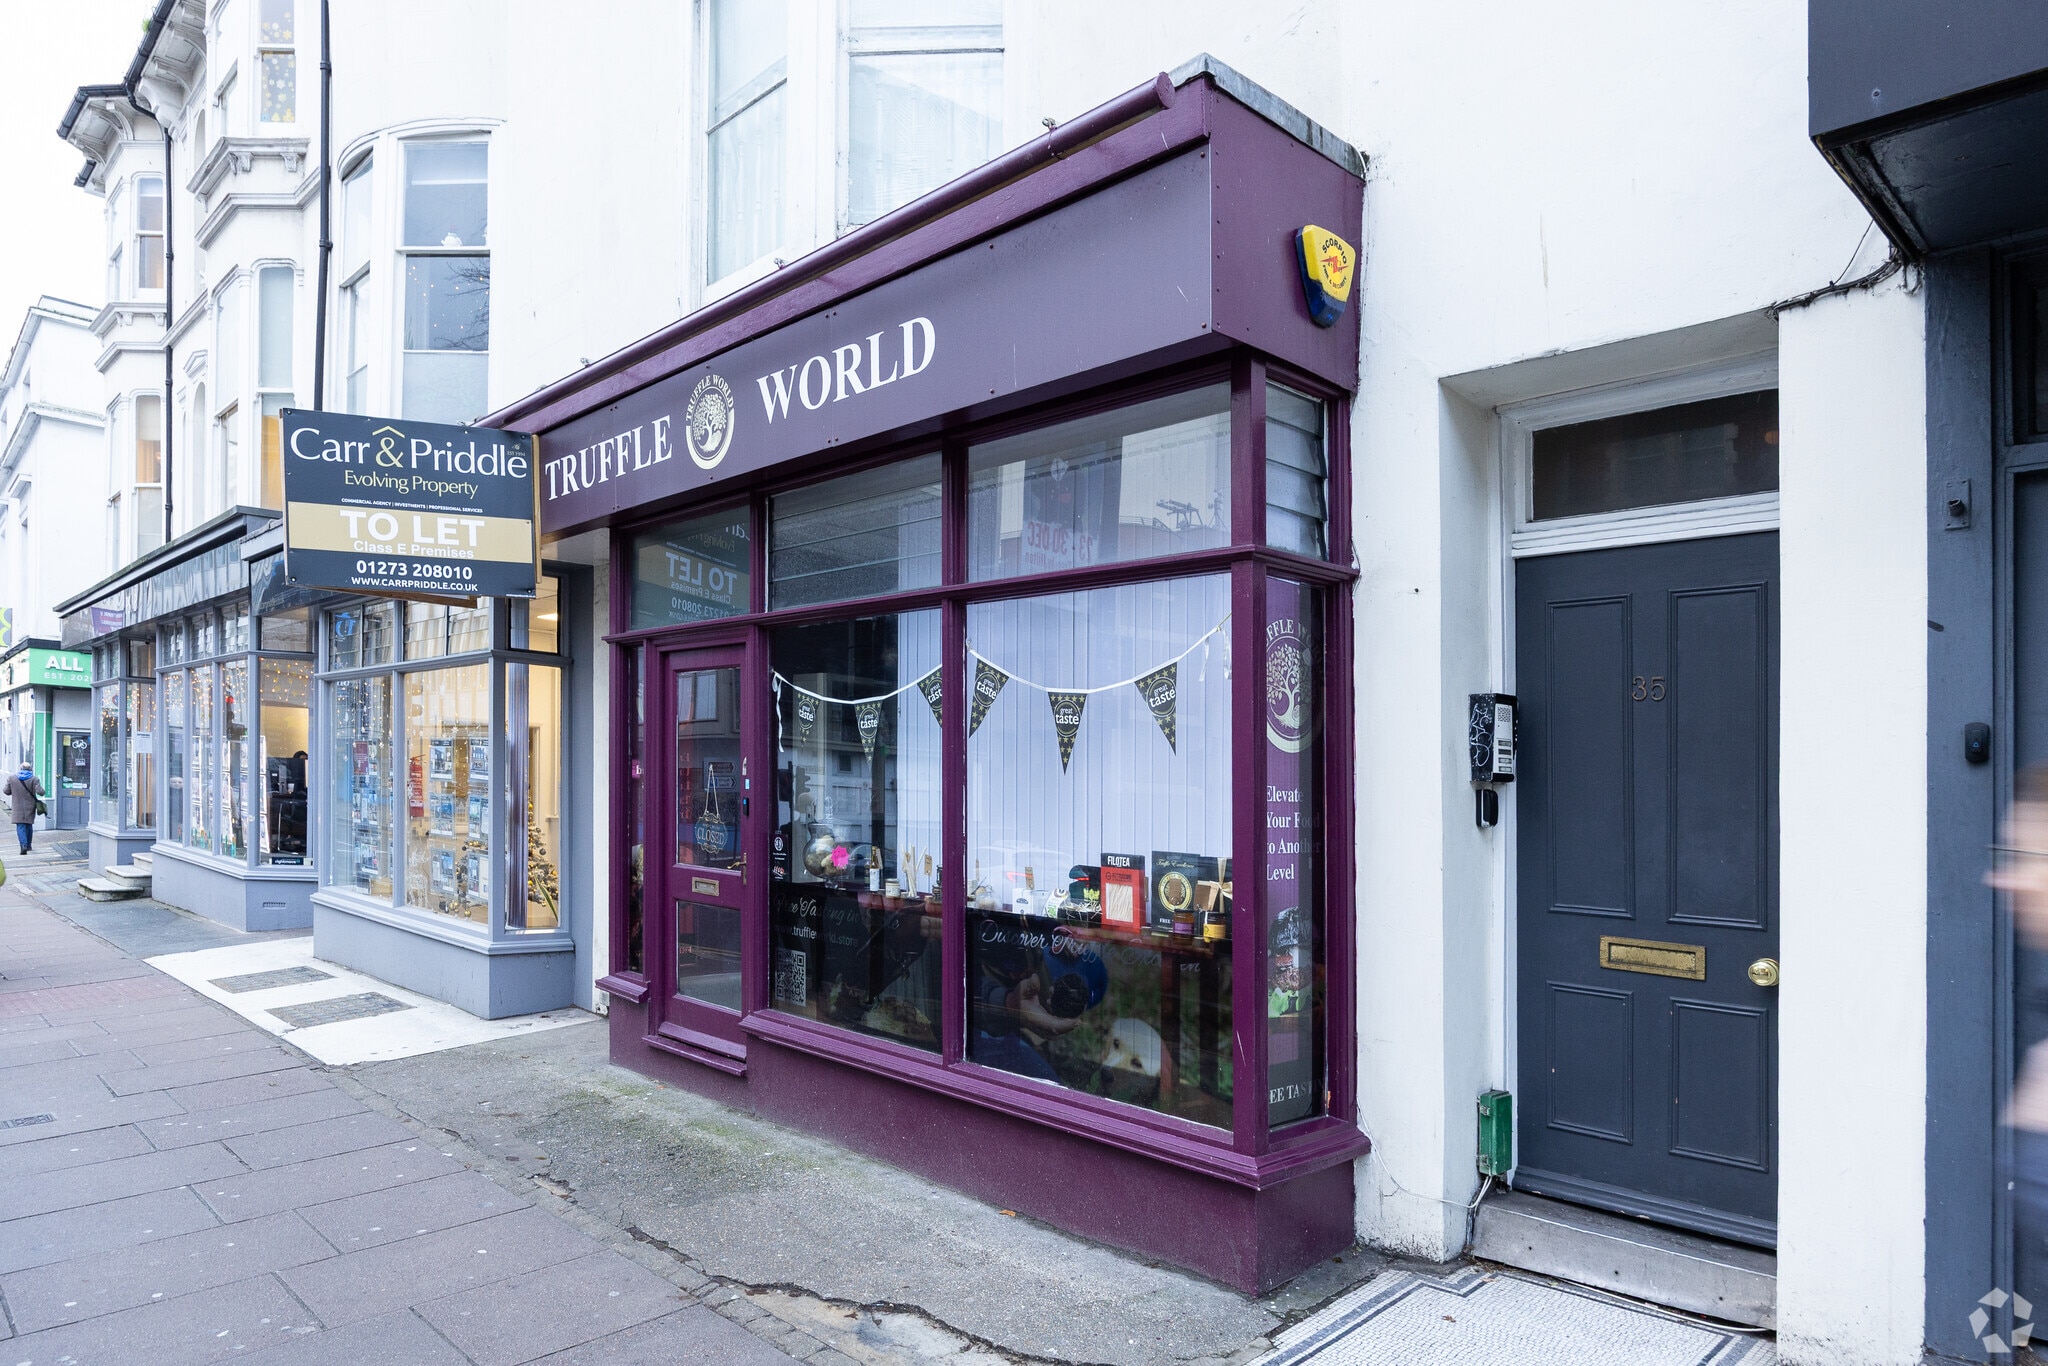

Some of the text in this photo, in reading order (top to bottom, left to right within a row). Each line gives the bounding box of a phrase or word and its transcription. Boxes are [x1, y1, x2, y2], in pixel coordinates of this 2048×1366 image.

[1322, 238, 1347, 264] SCORPIO
[686, 374, 734, 422] TRUFFLE WORLD
[544, 316, 936, 501] TRUFFLE WORLD
[290, 427, 527, 478] Carr & Priddle
[344, 469, 478, 499] Evolving Property
[341, 497, 372, 505] COMMERCIAL
[373, 499, 392, 507] AGENCY
[394, 501, 426, 509] INVESTMENTS
[428, 504, 462, 512] PROFESSIONAL
[339, 510, 485, 547] TO LET
[353, 540, 475, 559] Class E Premises
[356, 560, 473, 580] 01273 208010
[351, 576, 478, 592] WWW.CARRPRIDDLE.CO.UK
[45, 655, 84, 672] ALL
[976, 683, 998, 699] taste
[1154, 683, 1169, 696] great
[1632, 675, 1667, 702] 35
[1149, 689, 1176, 708] taste
[799, 710, 814, 722] taste
[1055, 713, 1080, 725] taste
[1060, 707, 1073, 716] great
[860, 718, 878, 729] taste
[1266, 785, 1304, 803] Elevate
[1266, 811, 1291, 828] Your
[697, 827, 725, 844] CLOSED
[1107, 855, 1131, 868] FILOTEA
[1266, 863, 1295, 881] Level
